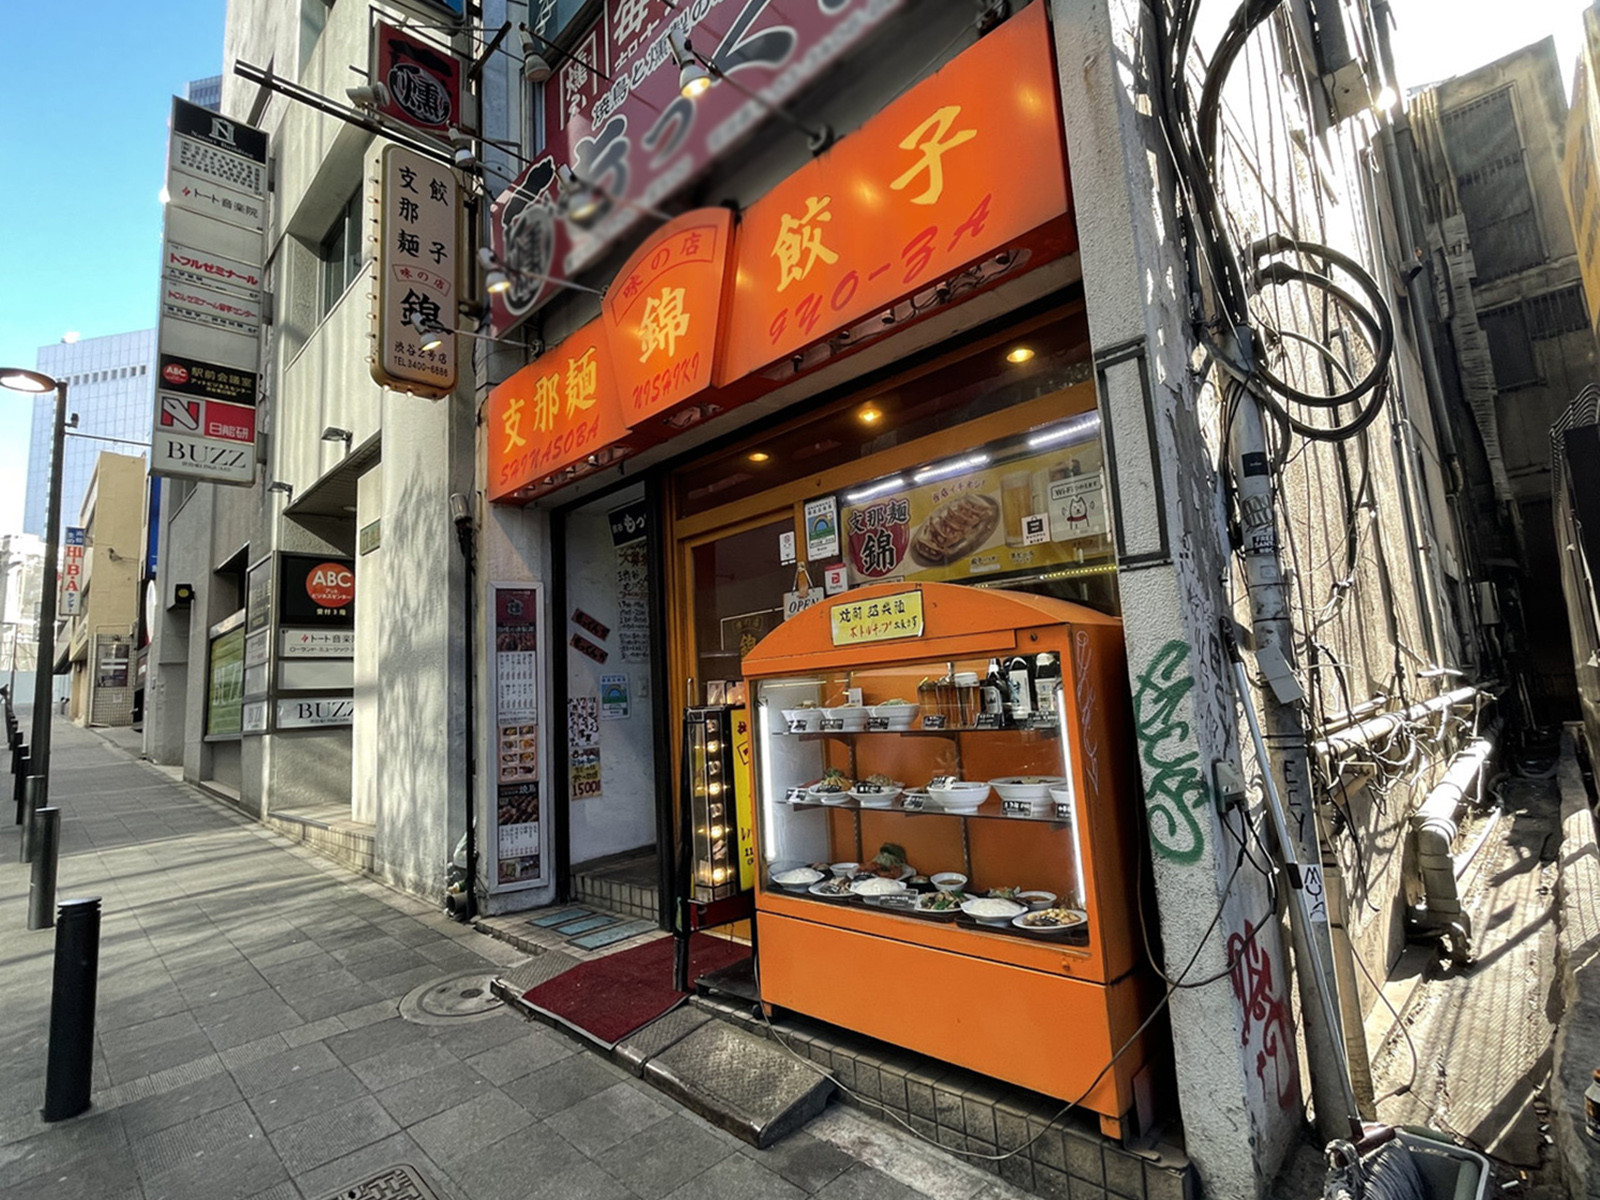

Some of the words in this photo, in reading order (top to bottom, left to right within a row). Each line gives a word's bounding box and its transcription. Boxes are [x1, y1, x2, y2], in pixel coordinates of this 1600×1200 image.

[194, 188, 259, 219] トート音楽院
[397, 166, 420, 258] 支那麺
[770, 104, 978, 293] 餃子
[428, 178, 448, 265] 餃子
[170, 253, 258, 285] トフルゼミナール
[399, 267, 445, 289] 味の店
[623, 232, 702, 299] 味の店
[639, 287, 690, 363] 錦
[166, 366, 187, 377] ABC
[394, 356, 406, 367] TEL
[502, 347, 597, 453] 支那麺
[209, 422, 249, 439] 日能研
[167, 441, 246, 469] BUZZ
[850, 500, 908, 534] 支那麺
[861, 530, 896, 574] 錦
[312, 570, 352, 588] ABC
[310, 634, 354, 645] トート音楽
